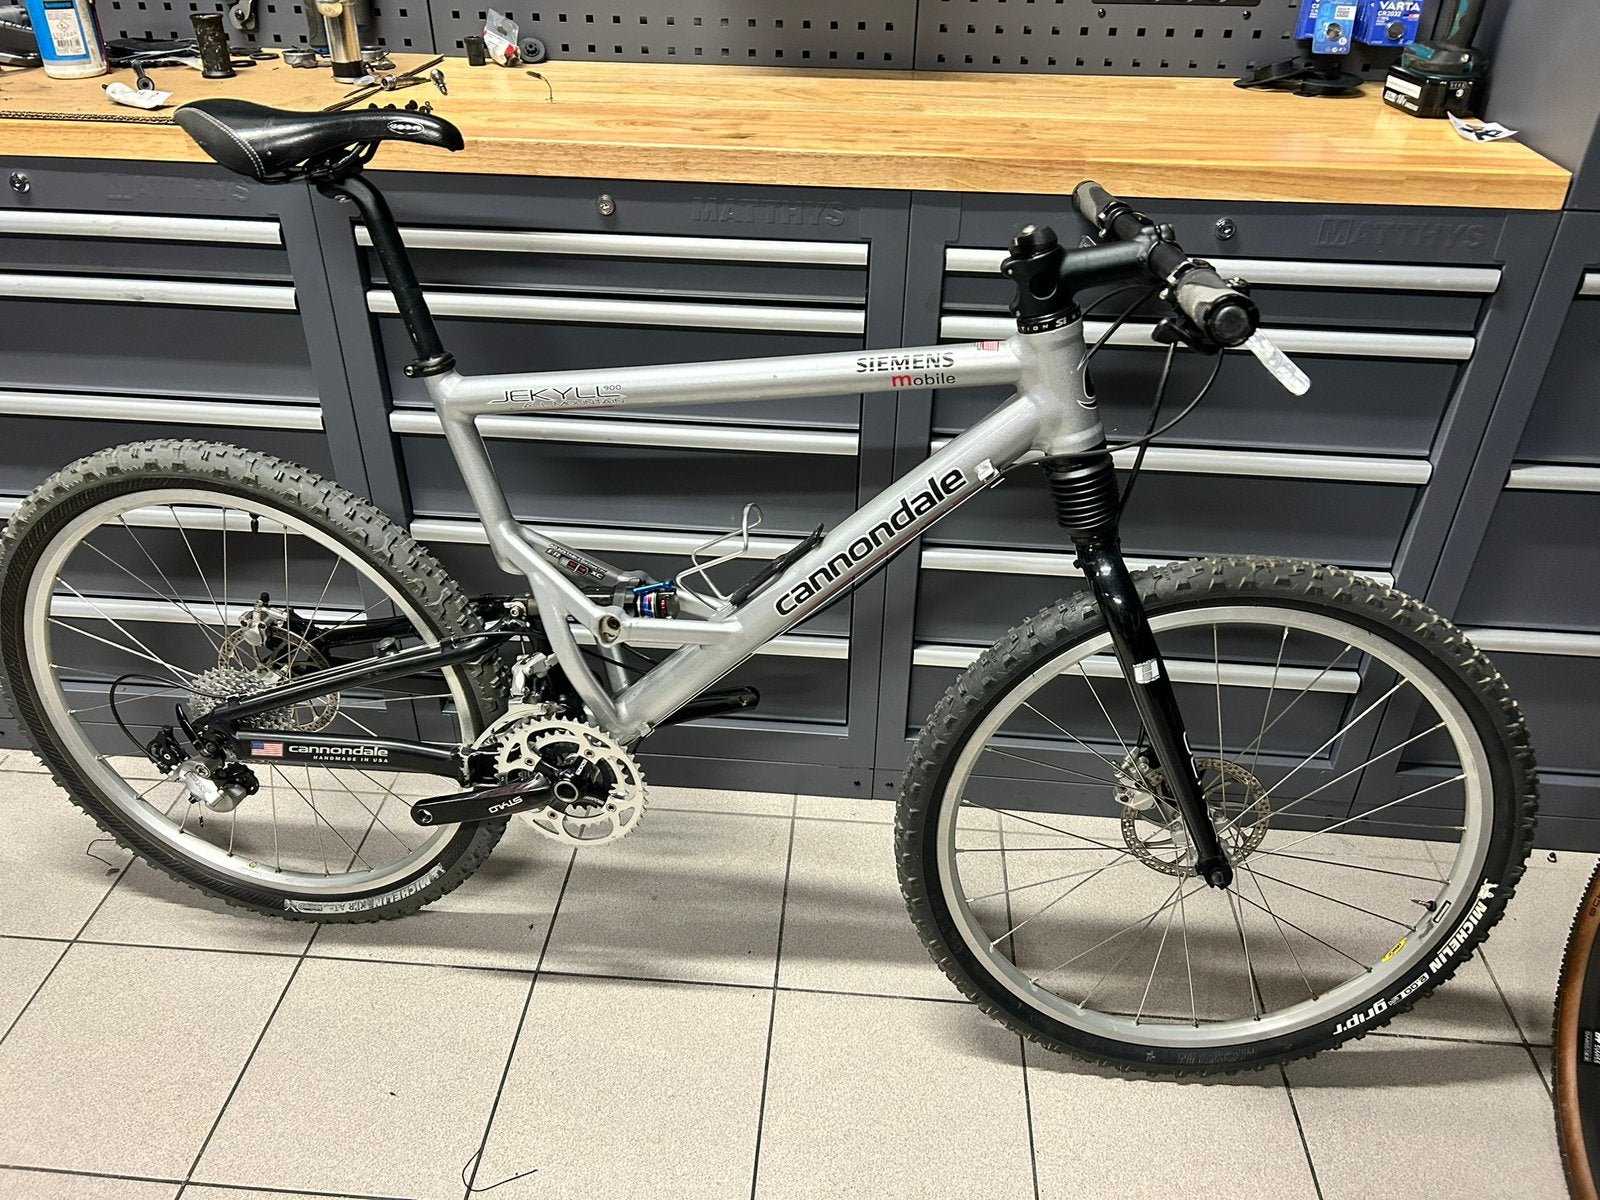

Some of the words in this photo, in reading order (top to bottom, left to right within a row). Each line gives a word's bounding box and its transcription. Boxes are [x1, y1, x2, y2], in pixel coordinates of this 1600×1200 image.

[1380, 1, 1420, 11] VARTA
[691, 196, 846, 227] MATTHYS
[1315, 218, 1488, 249] MATTHYS
[856, 352, 955, 373] SIEMENS
[891, 372, 956, 387] mobile
[488, 386, 625, 405] JEKYLL
[775, 468, 968, 616] cannondale
[288, 745, 389, 757] cannondale
[373, 876, 432, 909] MICHELIN
[1428, 900, 1488, 974] MICHELIN
[1403, 975, 1428, 995] 2.00
[1332, 998, 1389, 1035] grip'r
